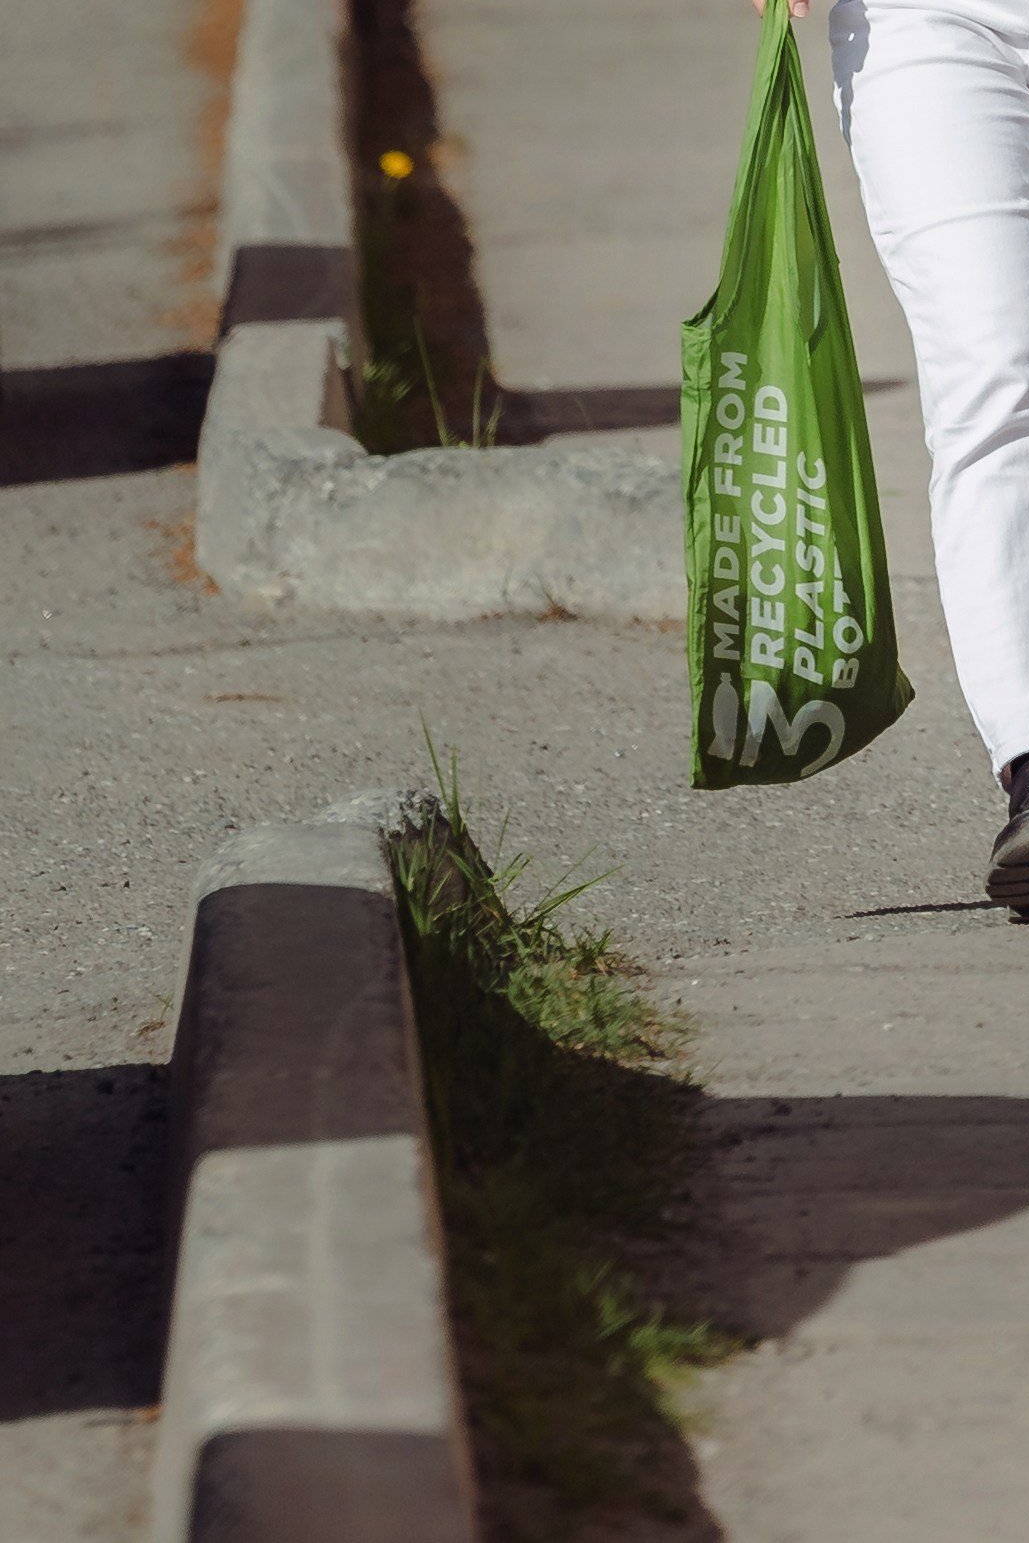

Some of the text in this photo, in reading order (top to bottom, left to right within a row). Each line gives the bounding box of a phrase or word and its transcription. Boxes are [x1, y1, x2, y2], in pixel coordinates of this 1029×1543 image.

[713, 351, 748, 662] MADE FROM
[750, 385, 788, 670] RECYCLED
[793, 450, 827, 686] PLASTIC
